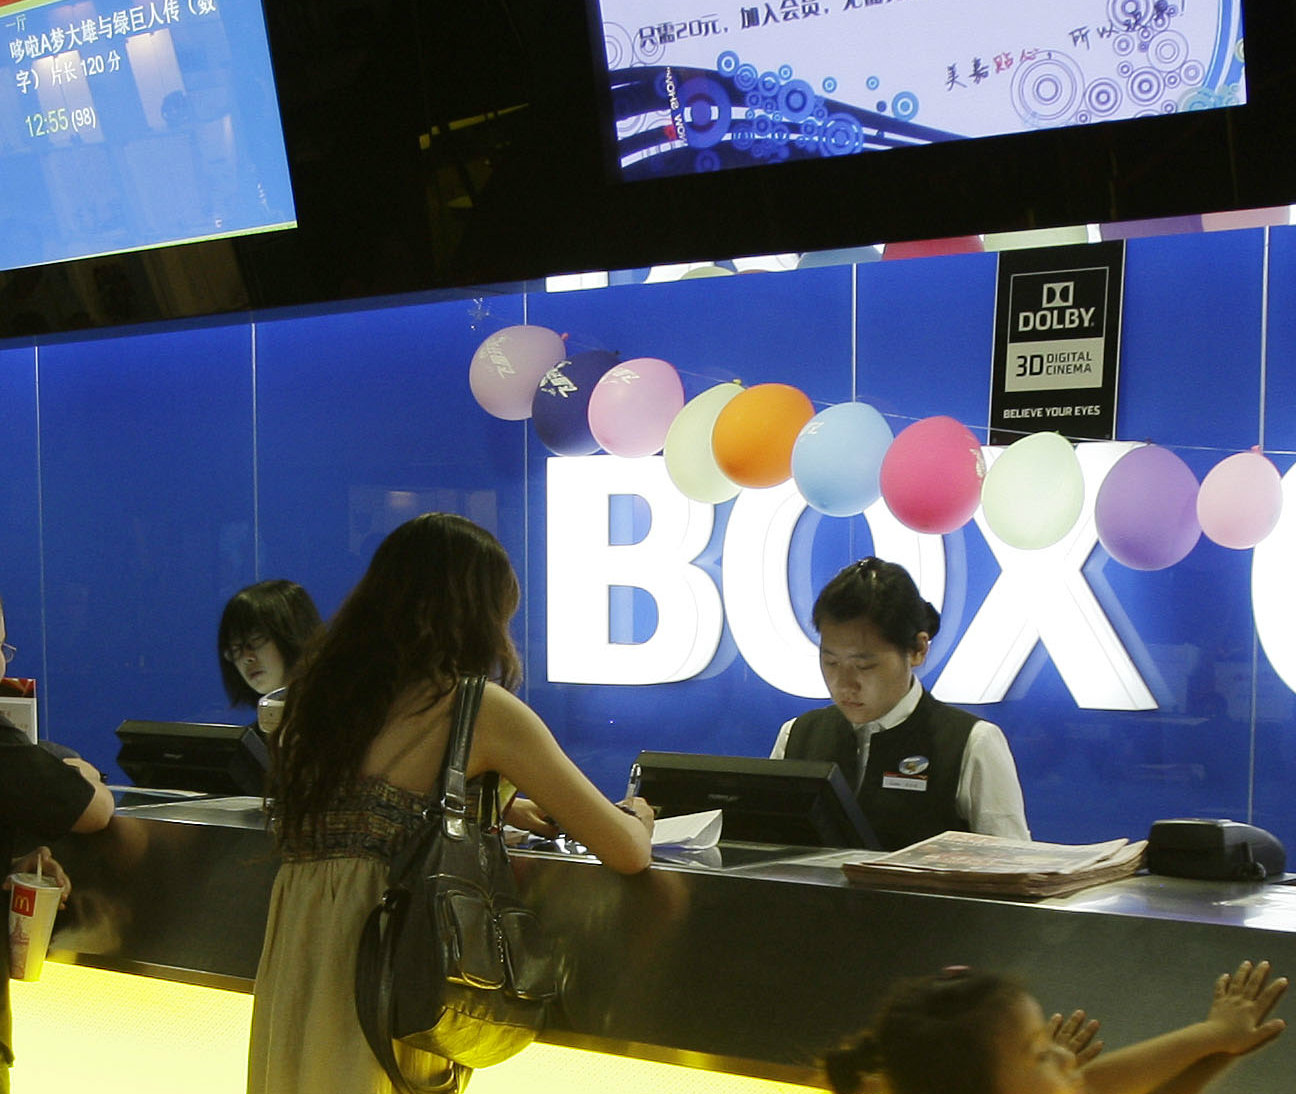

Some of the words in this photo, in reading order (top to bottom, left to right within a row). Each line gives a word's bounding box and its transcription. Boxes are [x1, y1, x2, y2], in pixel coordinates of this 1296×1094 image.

[80, 55, 104, 76] 120
[107, 49, 121, 73] 分
[25, 108, 69, 137] 12:55
[71, 106, 96, 132] (98)
[1018, 307, 1096, 332] DOLBY
[1015, 353, 1044, 377] 3D
[1047, 351, 1092, 364] DIGITAL
[1046, 363, 1092, 376] CINEMA
[1003, 407, 1044, 419] BELIEVE
[1045, 406, 1073, 418] YOUR
[1074, 405, 1101, 416] EYES
[546, 440, 1159, 710] BOX
